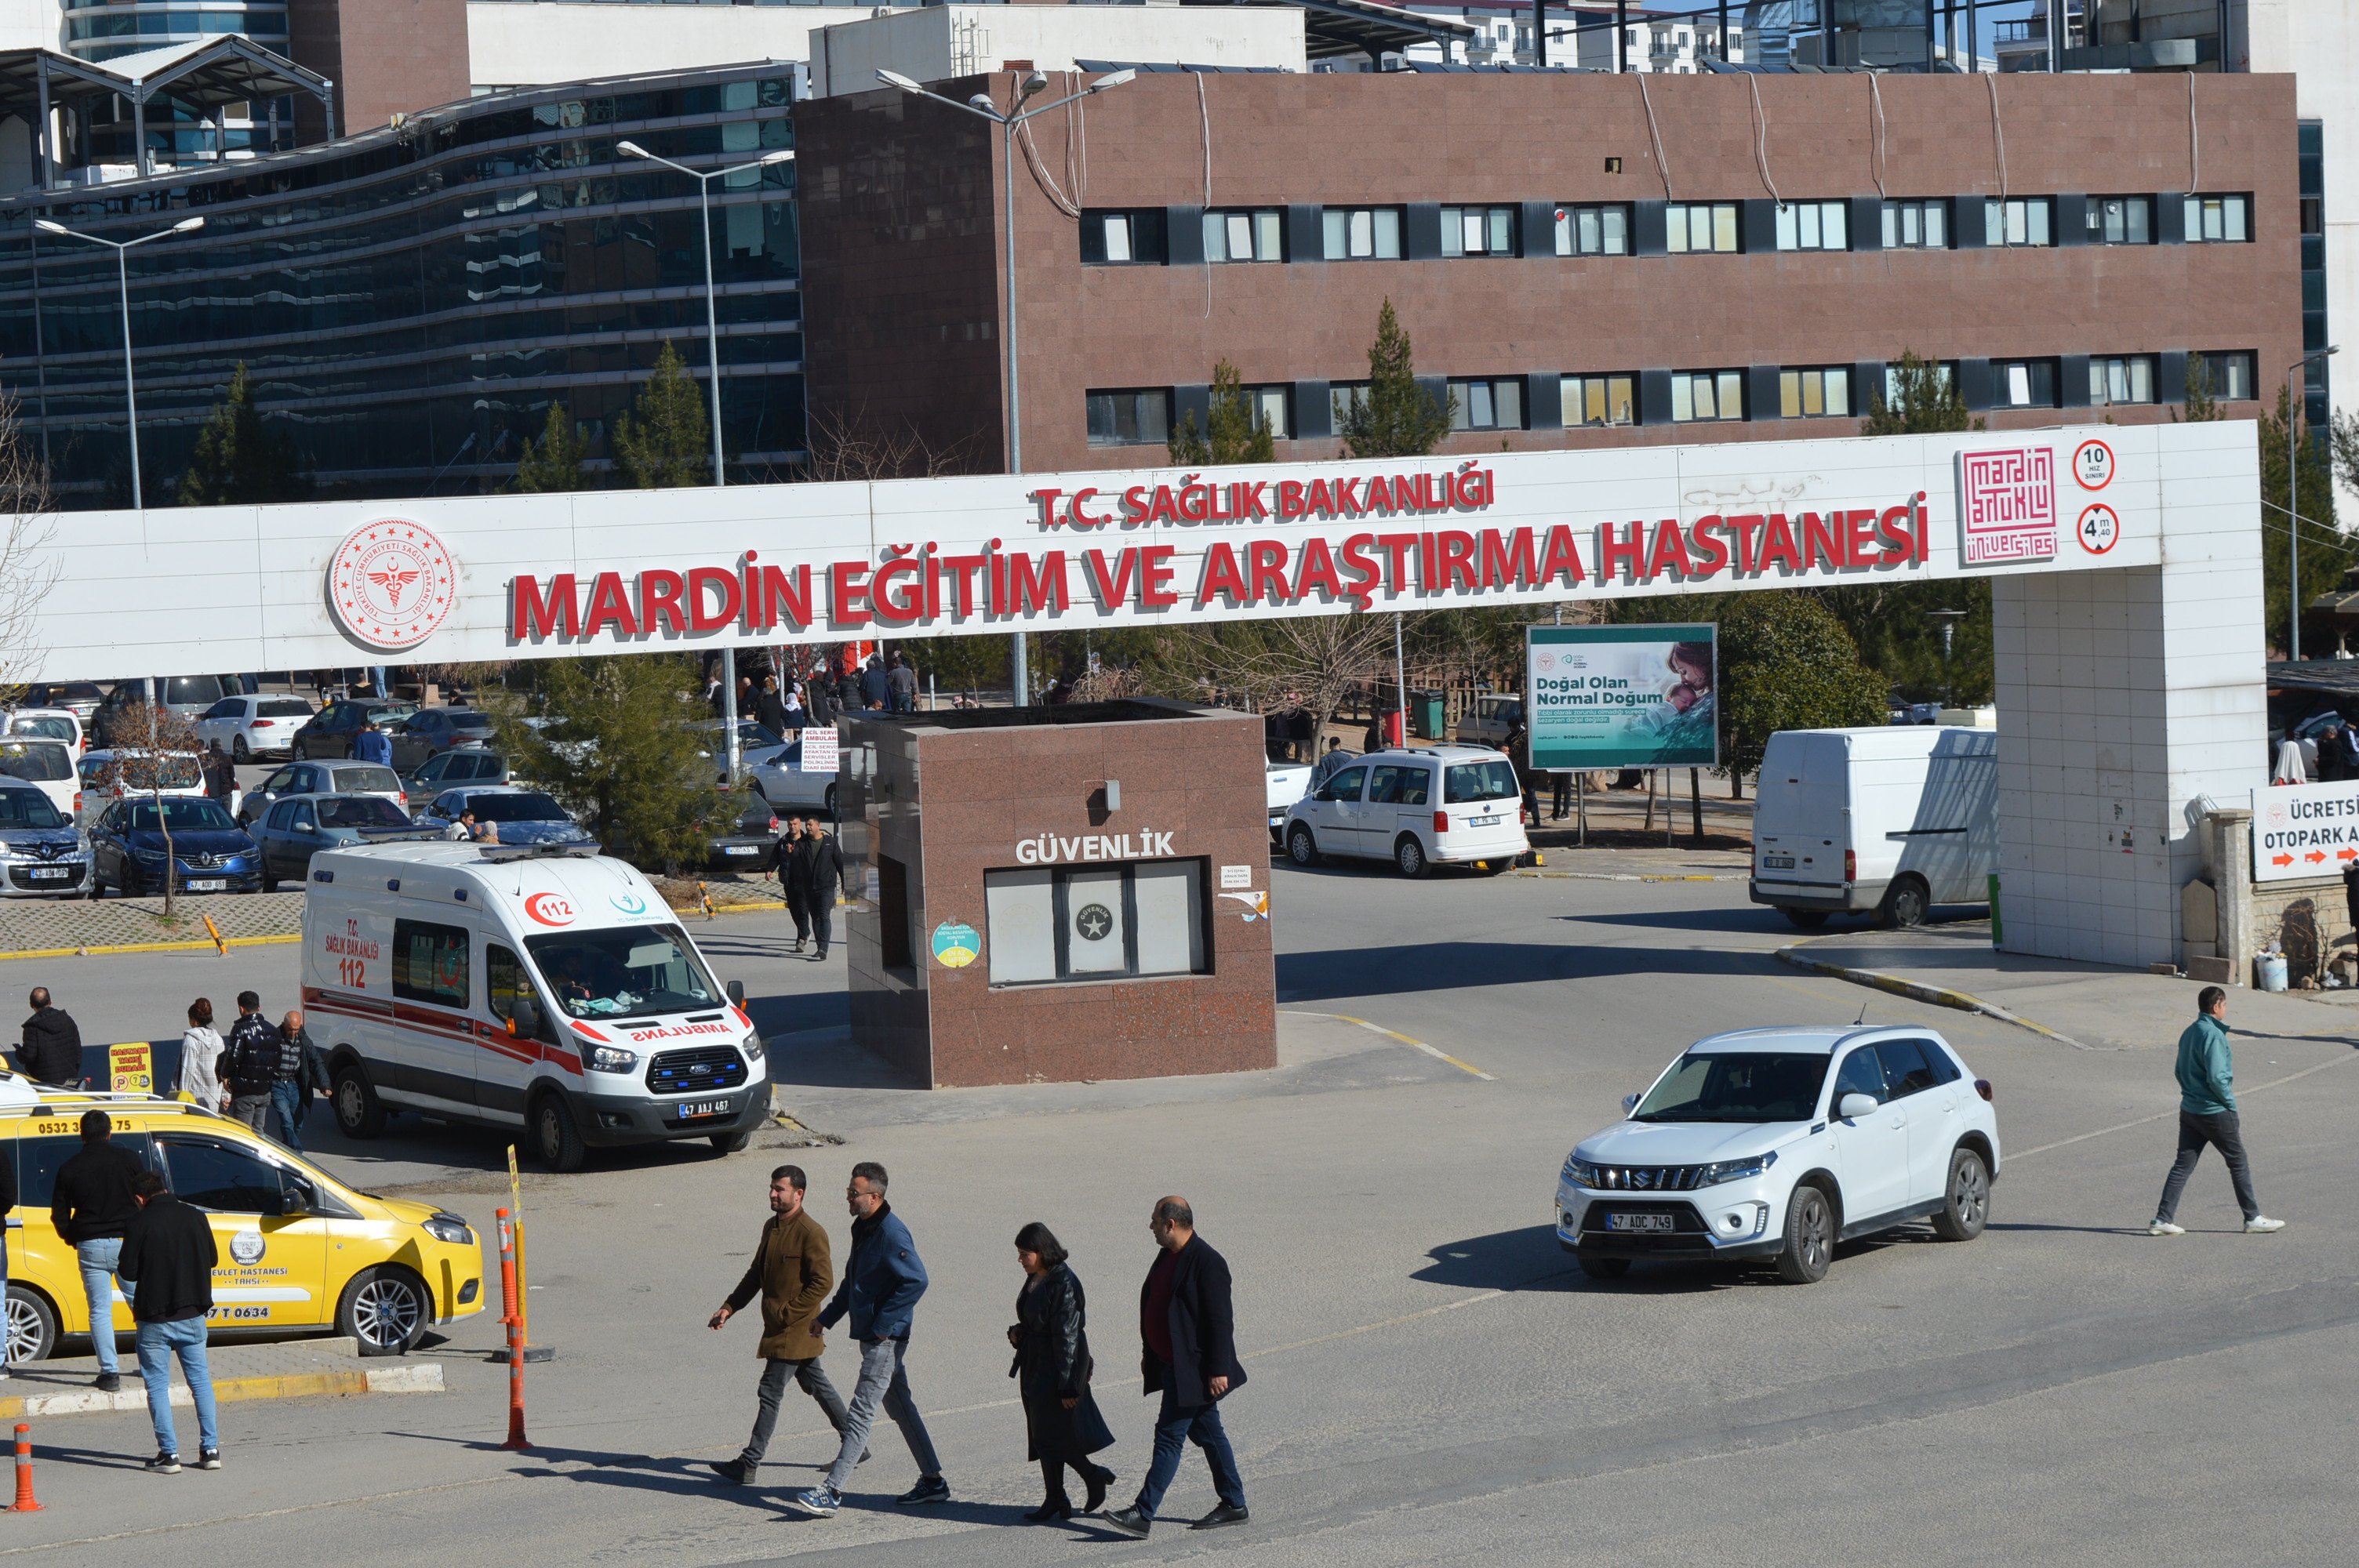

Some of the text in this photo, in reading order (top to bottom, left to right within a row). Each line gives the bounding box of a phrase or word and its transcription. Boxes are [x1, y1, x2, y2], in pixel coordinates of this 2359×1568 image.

[2084, 448, 2104, 463] 10
[1034, 459, 1494, 525] T.C. SAĞLIK BAKANLIĞI
[2085, 520, 2097, 537] 4
[2099, 518, 2110, 527] m
[512, 491, 1928, 638] MARDİN EĞİTİM VE ARAŞTIRMA HASTANESİ
[356, 542, 432, 618] TÜRKİYE CUMHURİYETİ SAĞLIK BAKANLIĞI
[1536, 676, 1628, 692] Doğal Olan
[1536, 691, 1663, 706] Normal Doğum
[1016, 827, 1176, 864] GÜVENLİK
[2265, 827, 2343, 849] OTOPARK
[541, 902, 573, 916] 112
[1080, 906, 1110, 920] GÜVENLİK
[347, 919, 358, 937] T.C.
[325, 933, 379, 960] SAĞLIK BAKANLIĞI
[340, 957, 365, 989] 112
[111, 1047, 148, 1056] HASTANE
[685, 1105, 694, 1115] 47
[699, 1102, 712, 1114] AAJ
[715, 1100, 729, 1112] 467
[38, 1123, 68, 1134] 0532
[116, 1120, 131, 1131] 75
[1613, 1215, 1670, 1229] 47 ADC 749
[222, 1308, 230, 1318] T
[234, 1307, 268, 1318] 0634
